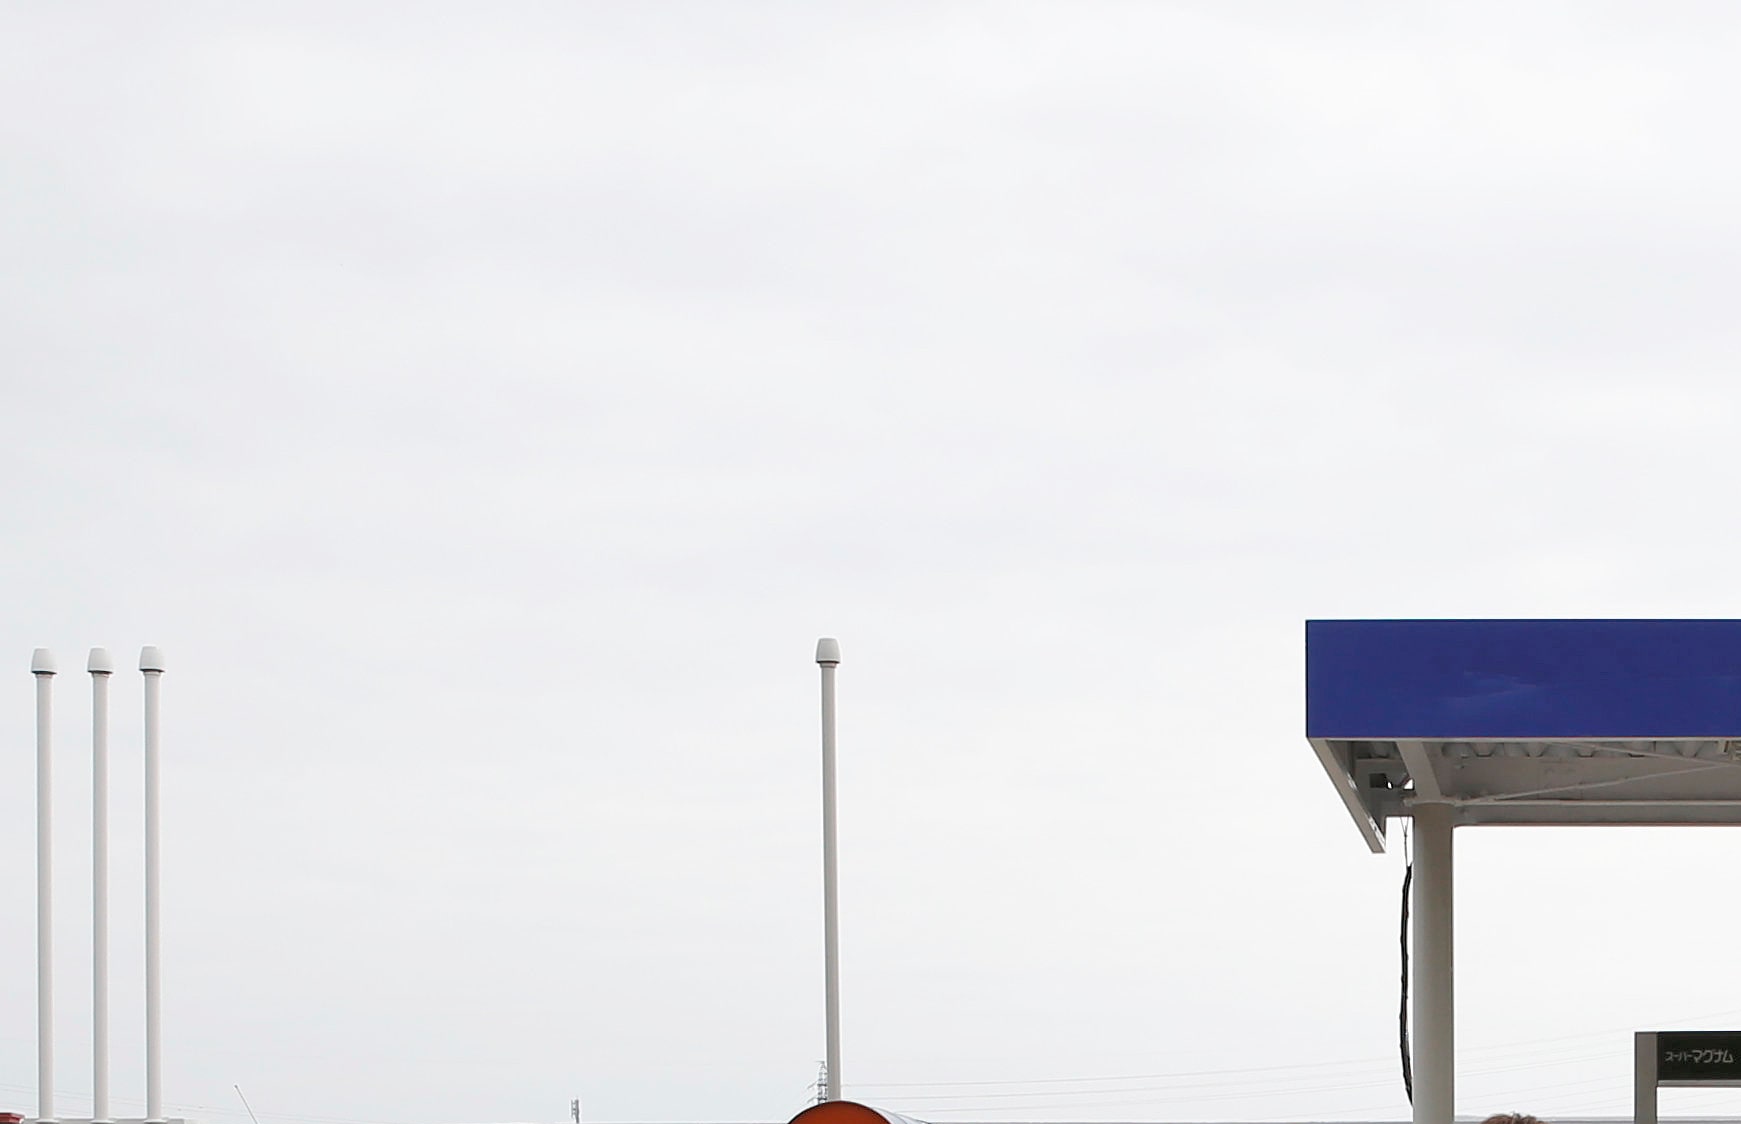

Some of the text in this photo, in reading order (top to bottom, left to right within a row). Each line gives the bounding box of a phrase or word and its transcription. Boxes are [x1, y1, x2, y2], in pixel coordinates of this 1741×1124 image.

[1665, 1050, 1734, 1063] スーパーマグナム
